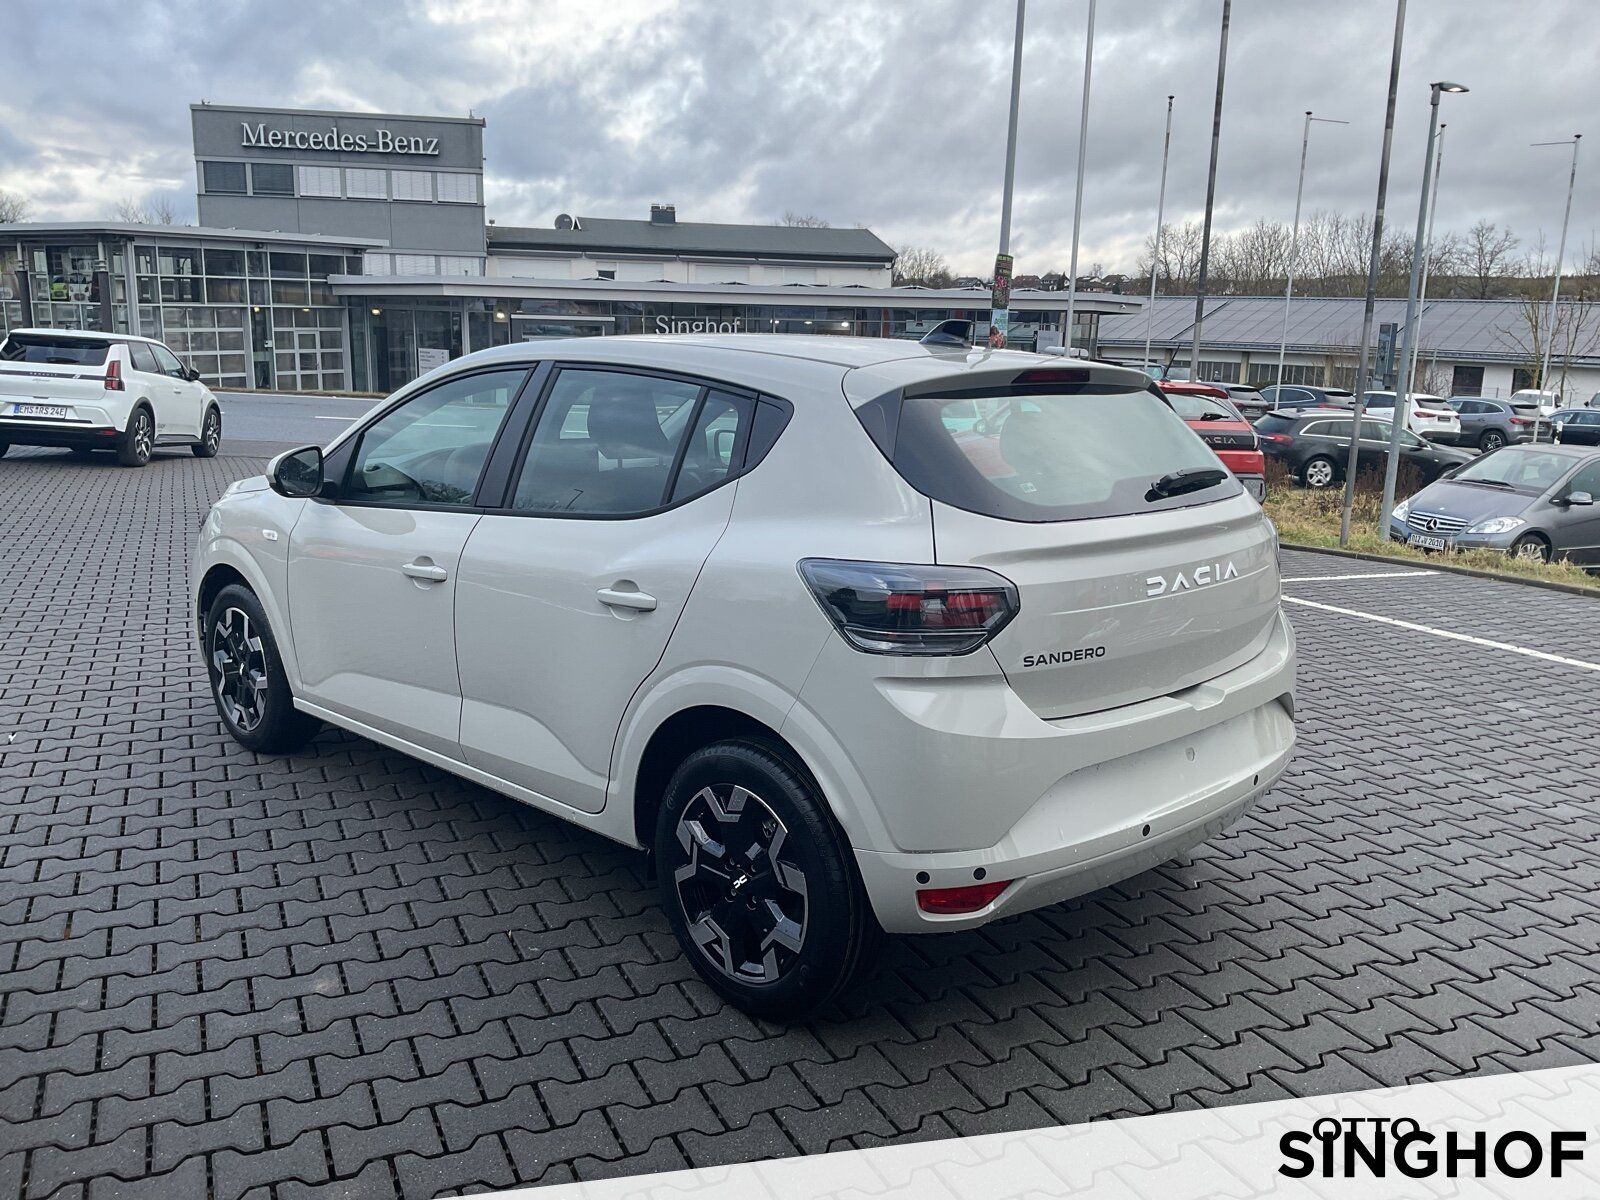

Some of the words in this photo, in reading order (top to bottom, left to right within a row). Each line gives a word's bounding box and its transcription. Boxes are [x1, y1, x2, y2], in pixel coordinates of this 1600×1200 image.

[241, 122, 440, 155] Mercedes-Benz
[655, 315, 742, 334] Singhof
[19, 405, 34, 414] EMS
[38, 406, 50, 415] RS
[50, 407, 65, 416] 24E
[1203, 436, 1237, 444] ACIA
[1146, 561, 1239, 597] DACIA
[1023, 646, 1106, 667] SANDERO
